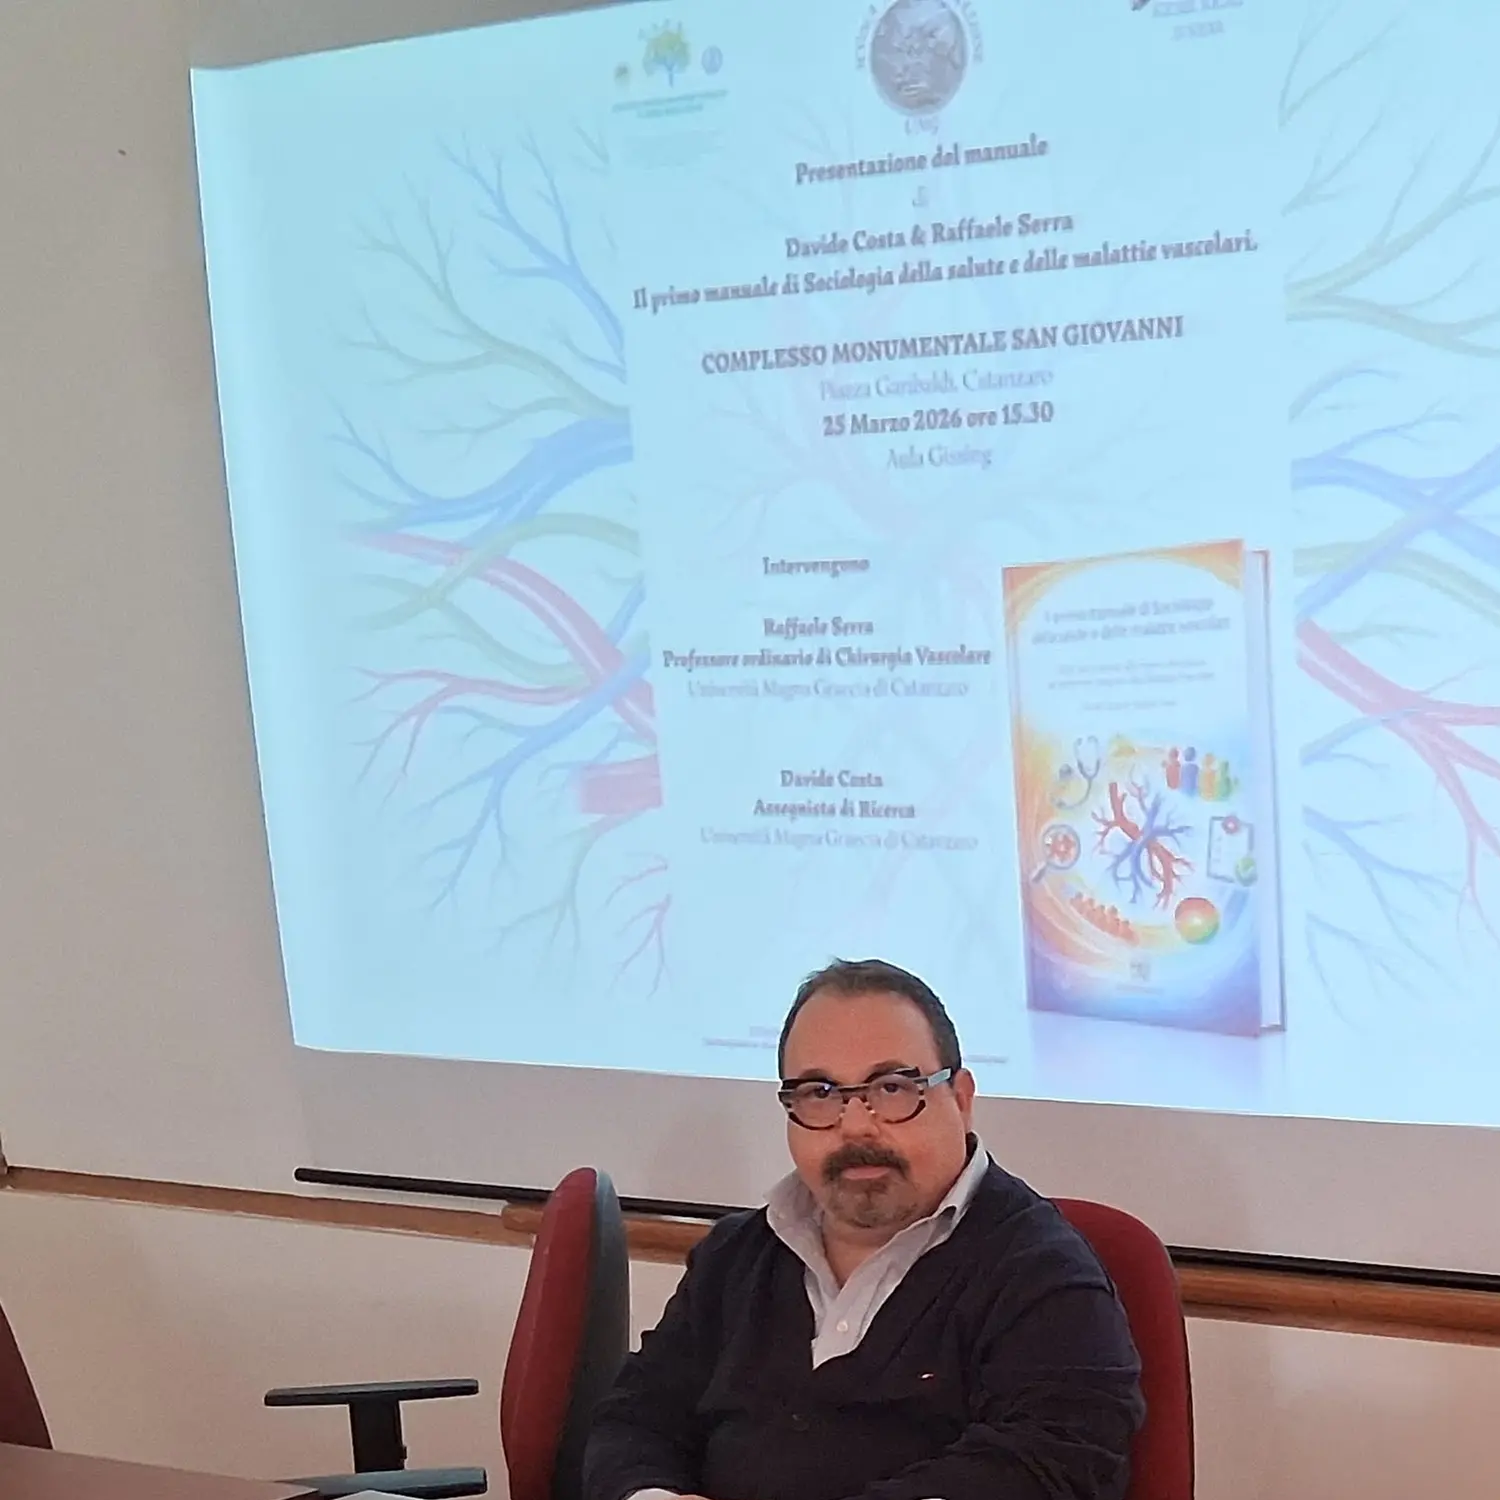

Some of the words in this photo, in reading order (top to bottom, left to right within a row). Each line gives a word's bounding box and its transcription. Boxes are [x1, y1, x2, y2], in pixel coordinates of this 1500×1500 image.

[795, 152, 928, 185] Presentazione
[931, 142, 960, 168] del
[964, 132, 1048, 164] manuale
[785, 231, 849, 258] Davide
[853, 230, 906, 251] Costa
[911, 224, 926, 246] &
[931, 215, 1014, 243] Raffaele
[1018, 213, 1074, 236] Serra
[633, 287, 648, 310] Il
[651, 285, 700, 313] primo
[704, 274, 779, 301] manuale
[782, 273, 800, 295] di
[803, 265, 894, 295] Sociologia
[899, 260, 943, 283] della
[948, 256, 1004, 280] salute
[1009, 258, 1020, 274] e
[1023, 248, 1069, 273] delle
[1072, 240, 1157, 268] malattie
[1161, 228, 1258, 260] vascolari.
[701, 346, 828, 376] COMPLESSO
[832, 329, 1008, 365] MONUMENTALE
[1012, 325, 1059, 350] SAN
[1063, 314, 1186, 347] GIOVANNI
[823, 414, 845, 437] 25
[850, 411, 911, 436] Marzo
[913, 407, 963, 431] 2026
[966, 410, 998, 428] ore
[764, 616, 827, 640] Raffaele
[831, 615, 874, 636] Serra
[780, 768, 835, 788] Davide
[837, 769, 884, 788] Costa
[752, 798, 836, 823] Assegnista
[840, 797, 856, 818] di
[858, 799, 916, 819] Ricerca
